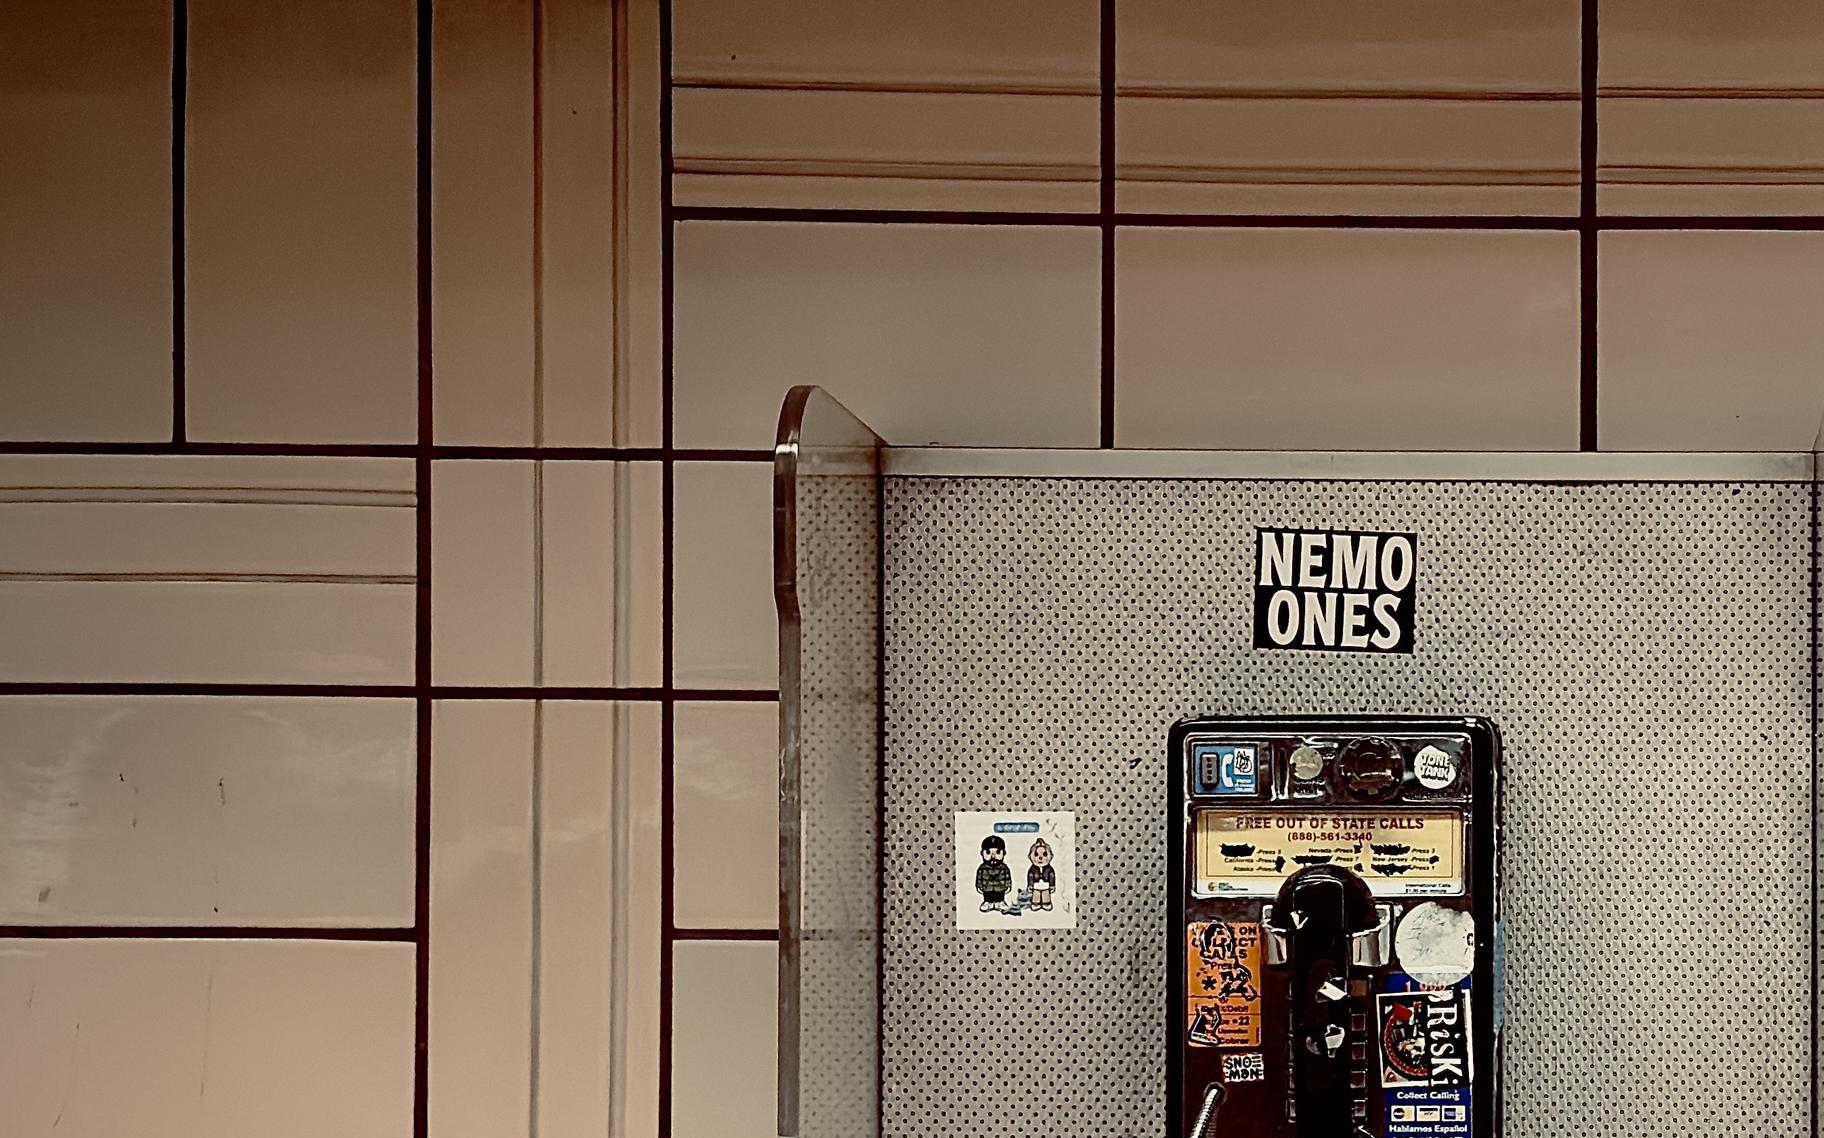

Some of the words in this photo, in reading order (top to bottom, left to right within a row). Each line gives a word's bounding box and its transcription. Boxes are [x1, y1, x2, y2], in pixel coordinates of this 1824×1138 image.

[1259, 532, 1413, 592] NEMO
[1267, 589, 1402, 649] ONES
[1421, 753, 1450, 767] TONE
[1420, 765, 1450, 781] TANK
[1236, 817, 1271, 829] FREE
[1276, 817, 1304, 829] OUT
[1309, 818, 1328, 829] OF
[1332, 818, 1375, 830] STATE
[1380, 818, 1424, 830] CALLS
[1287, 832, 1373, 842] (888)-561-3340
[1239, 926, 1257, 935] ON
[1211, 961, 1235, 970] Pres
[1396, 1091, 1428, 1099] Collect
[1429, 1091, 1460, 1101] Calling
[1389, 1124, 1433, 1133] Hablamos
[1434, 1124, 1468, 1134] Español
